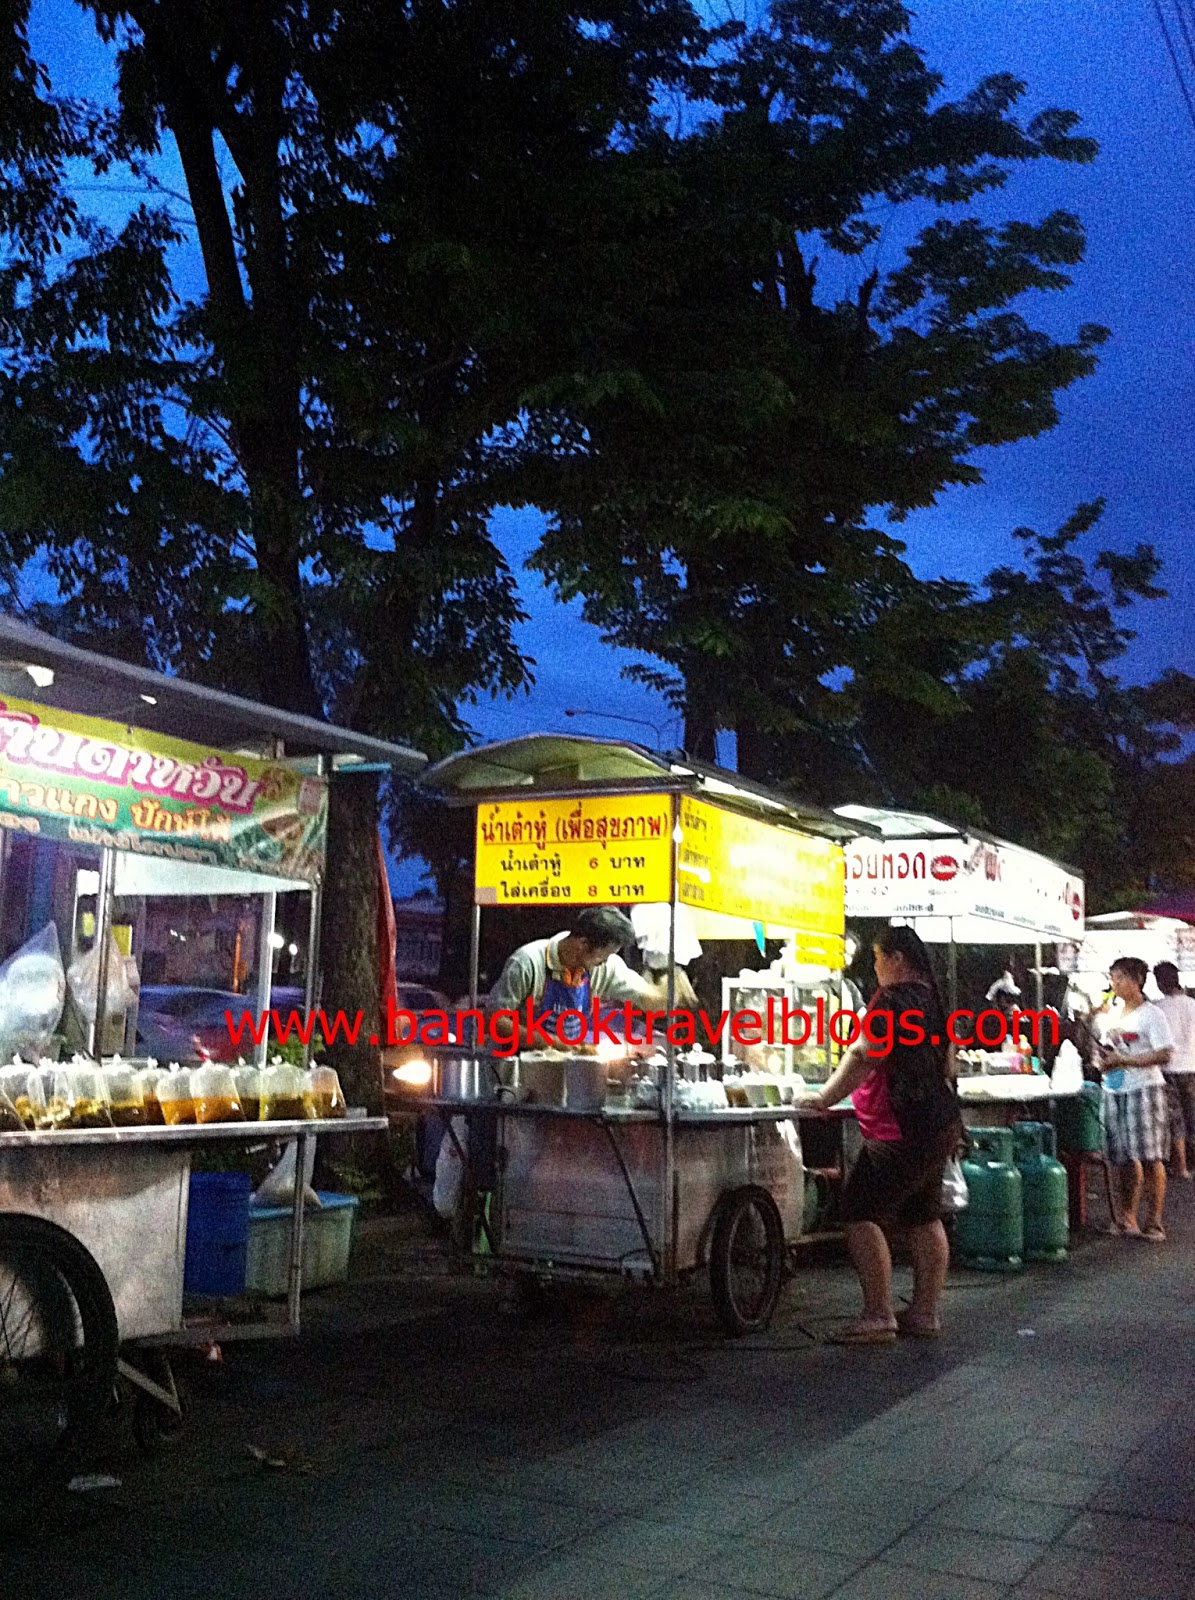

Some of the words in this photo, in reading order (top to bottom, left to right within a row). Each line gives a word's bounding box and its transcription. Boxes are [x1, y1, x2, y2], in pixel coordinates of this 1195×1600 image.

[481, 805, 547, 850] น้ำเต้าหู้
[556, 801, 668, 850] (เพื่อสุขภาพ)
[500, 849, 561, 876] น้ำเต้าหู้
[588, 857, 599, 869] 6
[609, 855, 645, 869] บาท
[587, 884, 598, 897] 8
[609, 884, 645, 897] บาท
